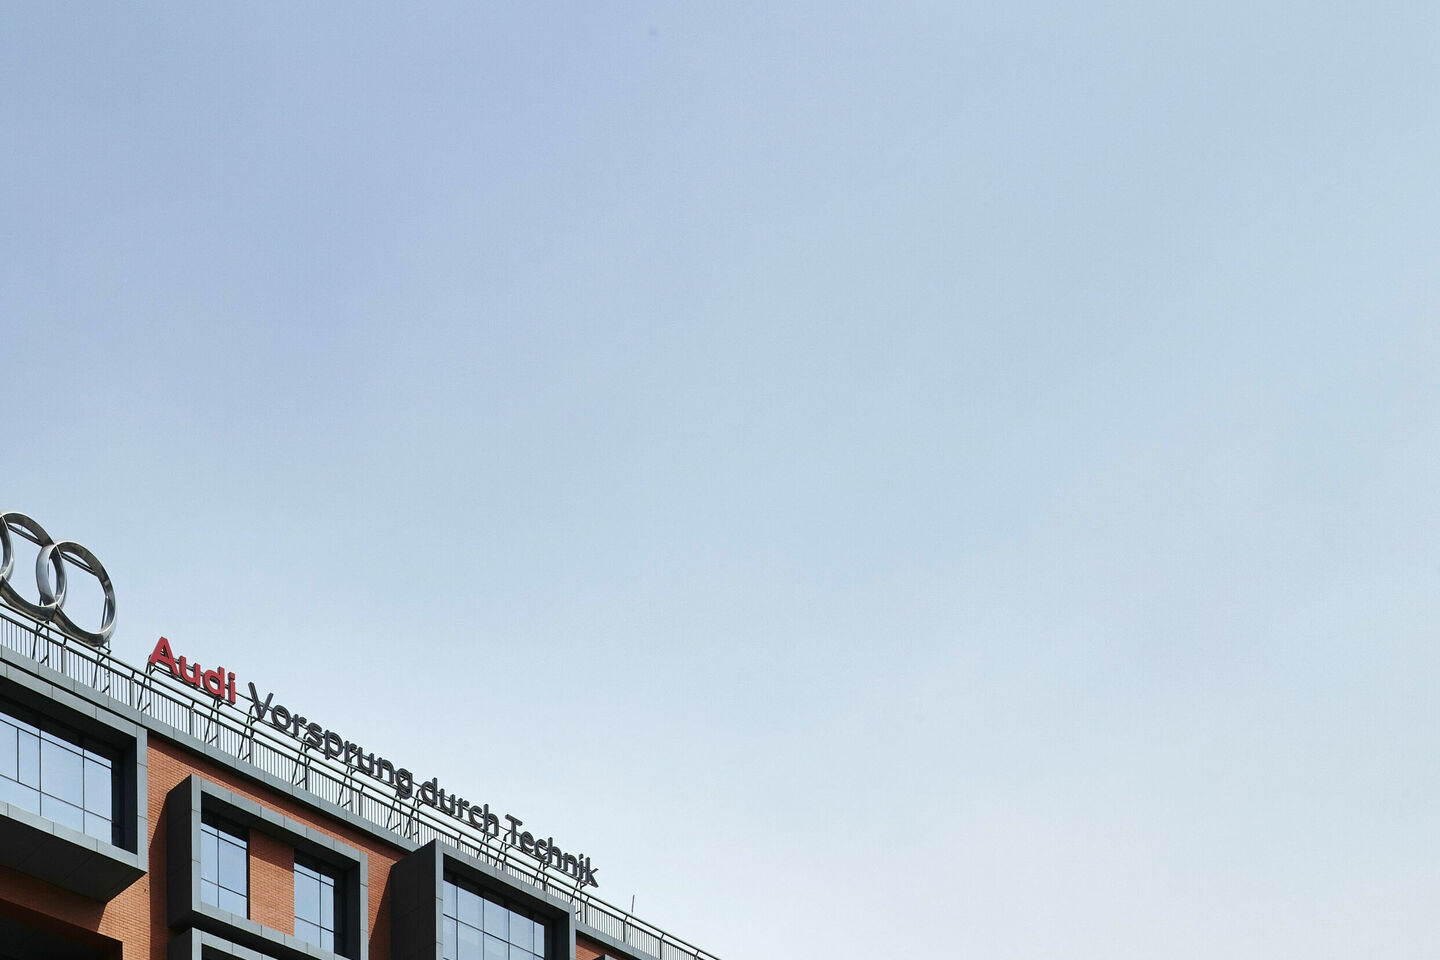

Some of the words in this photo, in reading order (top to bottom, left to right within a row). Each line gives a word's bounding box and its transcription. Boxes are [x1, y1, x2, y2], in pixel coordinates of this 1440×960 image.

[149, 636, 236, 705] Audi
[247, 681, 413, 800] Vorsprung
[420, 777, 500, 837] durch
[505, 814, 599, 888] Technik
